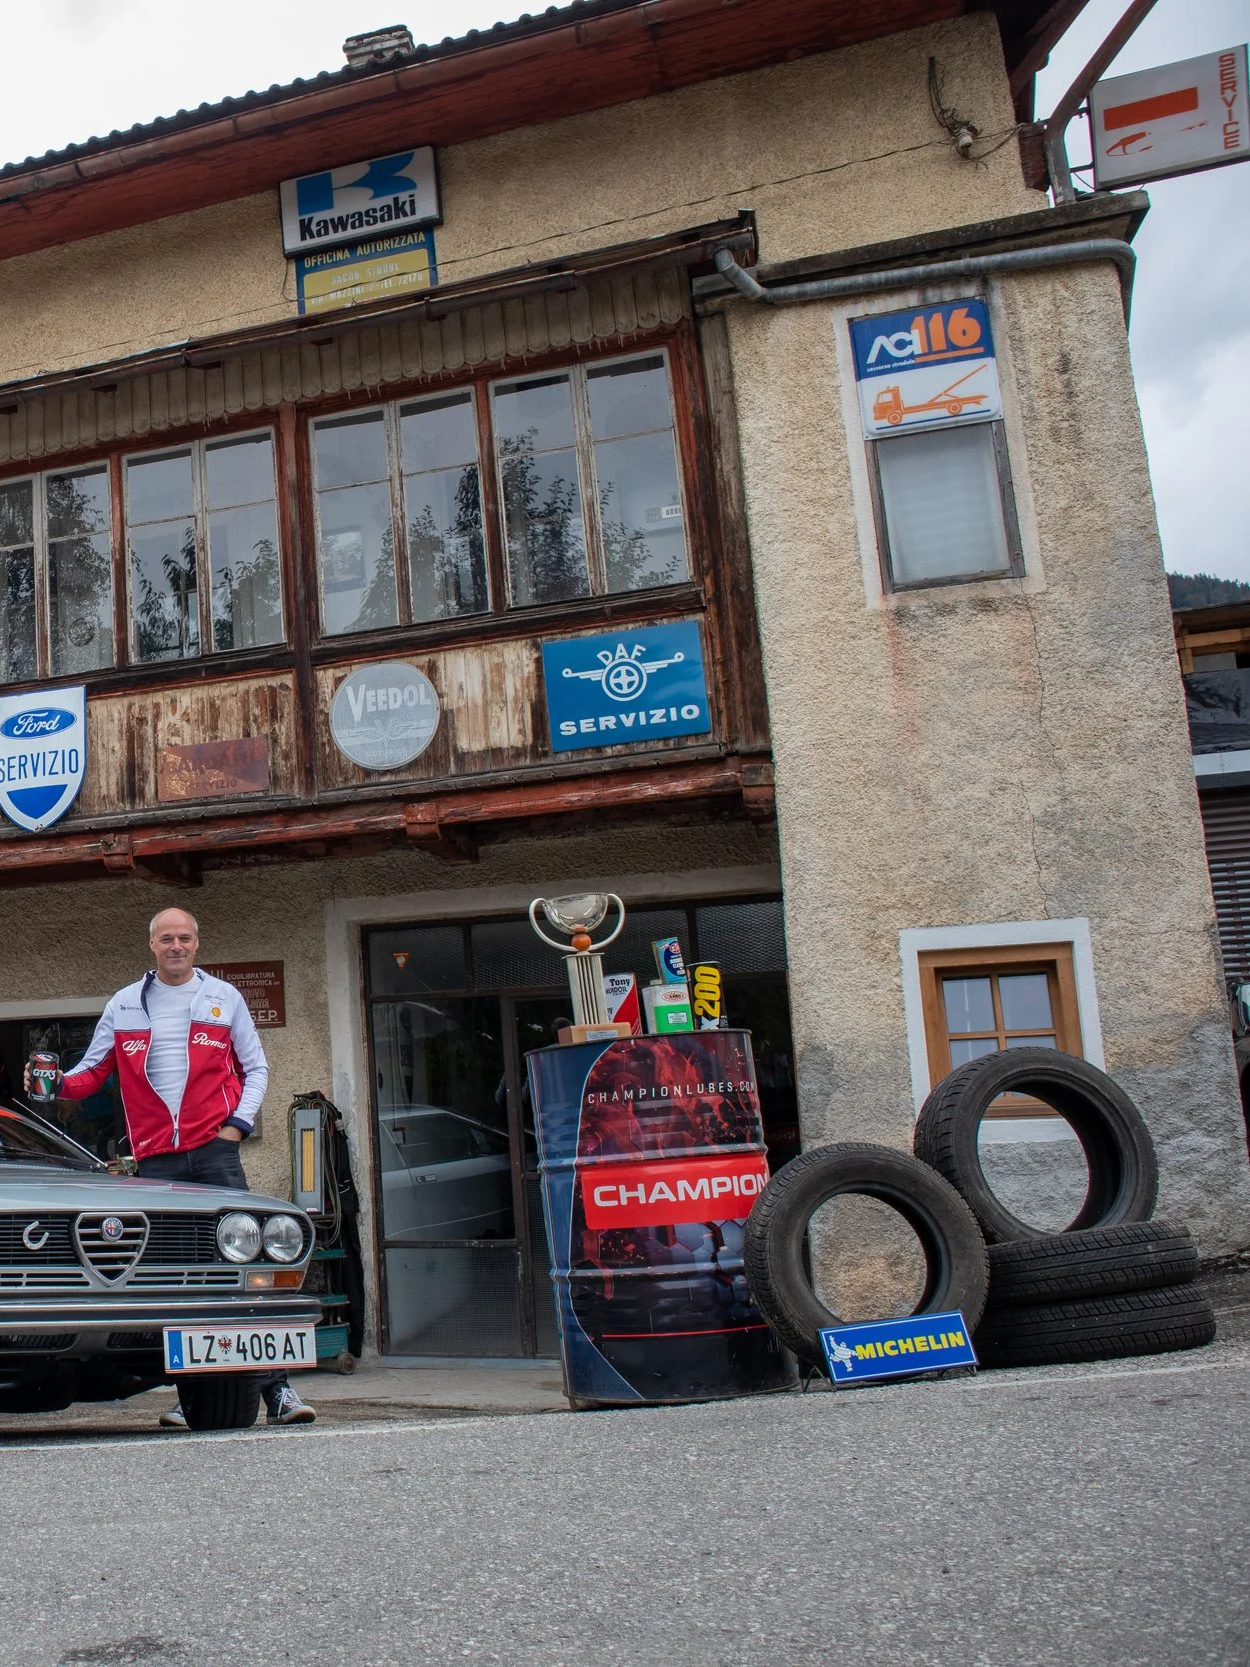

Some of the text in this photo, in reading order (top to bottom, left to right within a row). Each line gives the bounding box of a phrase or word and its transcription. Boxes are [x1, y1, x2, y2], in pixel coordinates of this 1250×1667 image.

[1218, 52, 1241, 150] SERVICE
[299, 193, 417, 242] Kawasaki
[304, 231, 426, 268] OFFICINA AUTORIZZATA
[866, 307, 981, 364] ACI 116
[596, 643, 646, 666] DAF
[345, 683, 432, 722] VEEDOL
[12, 711, 61, 735] Ford
[559, 704, 700, 736] SERVIZIO
[609, 978, 630, 987] Tony
[122, 1032, 227, 1056] Alfa Romeo
[33, 1068, 56, 1080] GTX3
[593, 1172, 768, 1207] CHAMPION
[172, 1354, 180, 1364] A
[188, 1334, 217, 1363] LZ
[855, 1330, 966, 1361] MICHELIN
